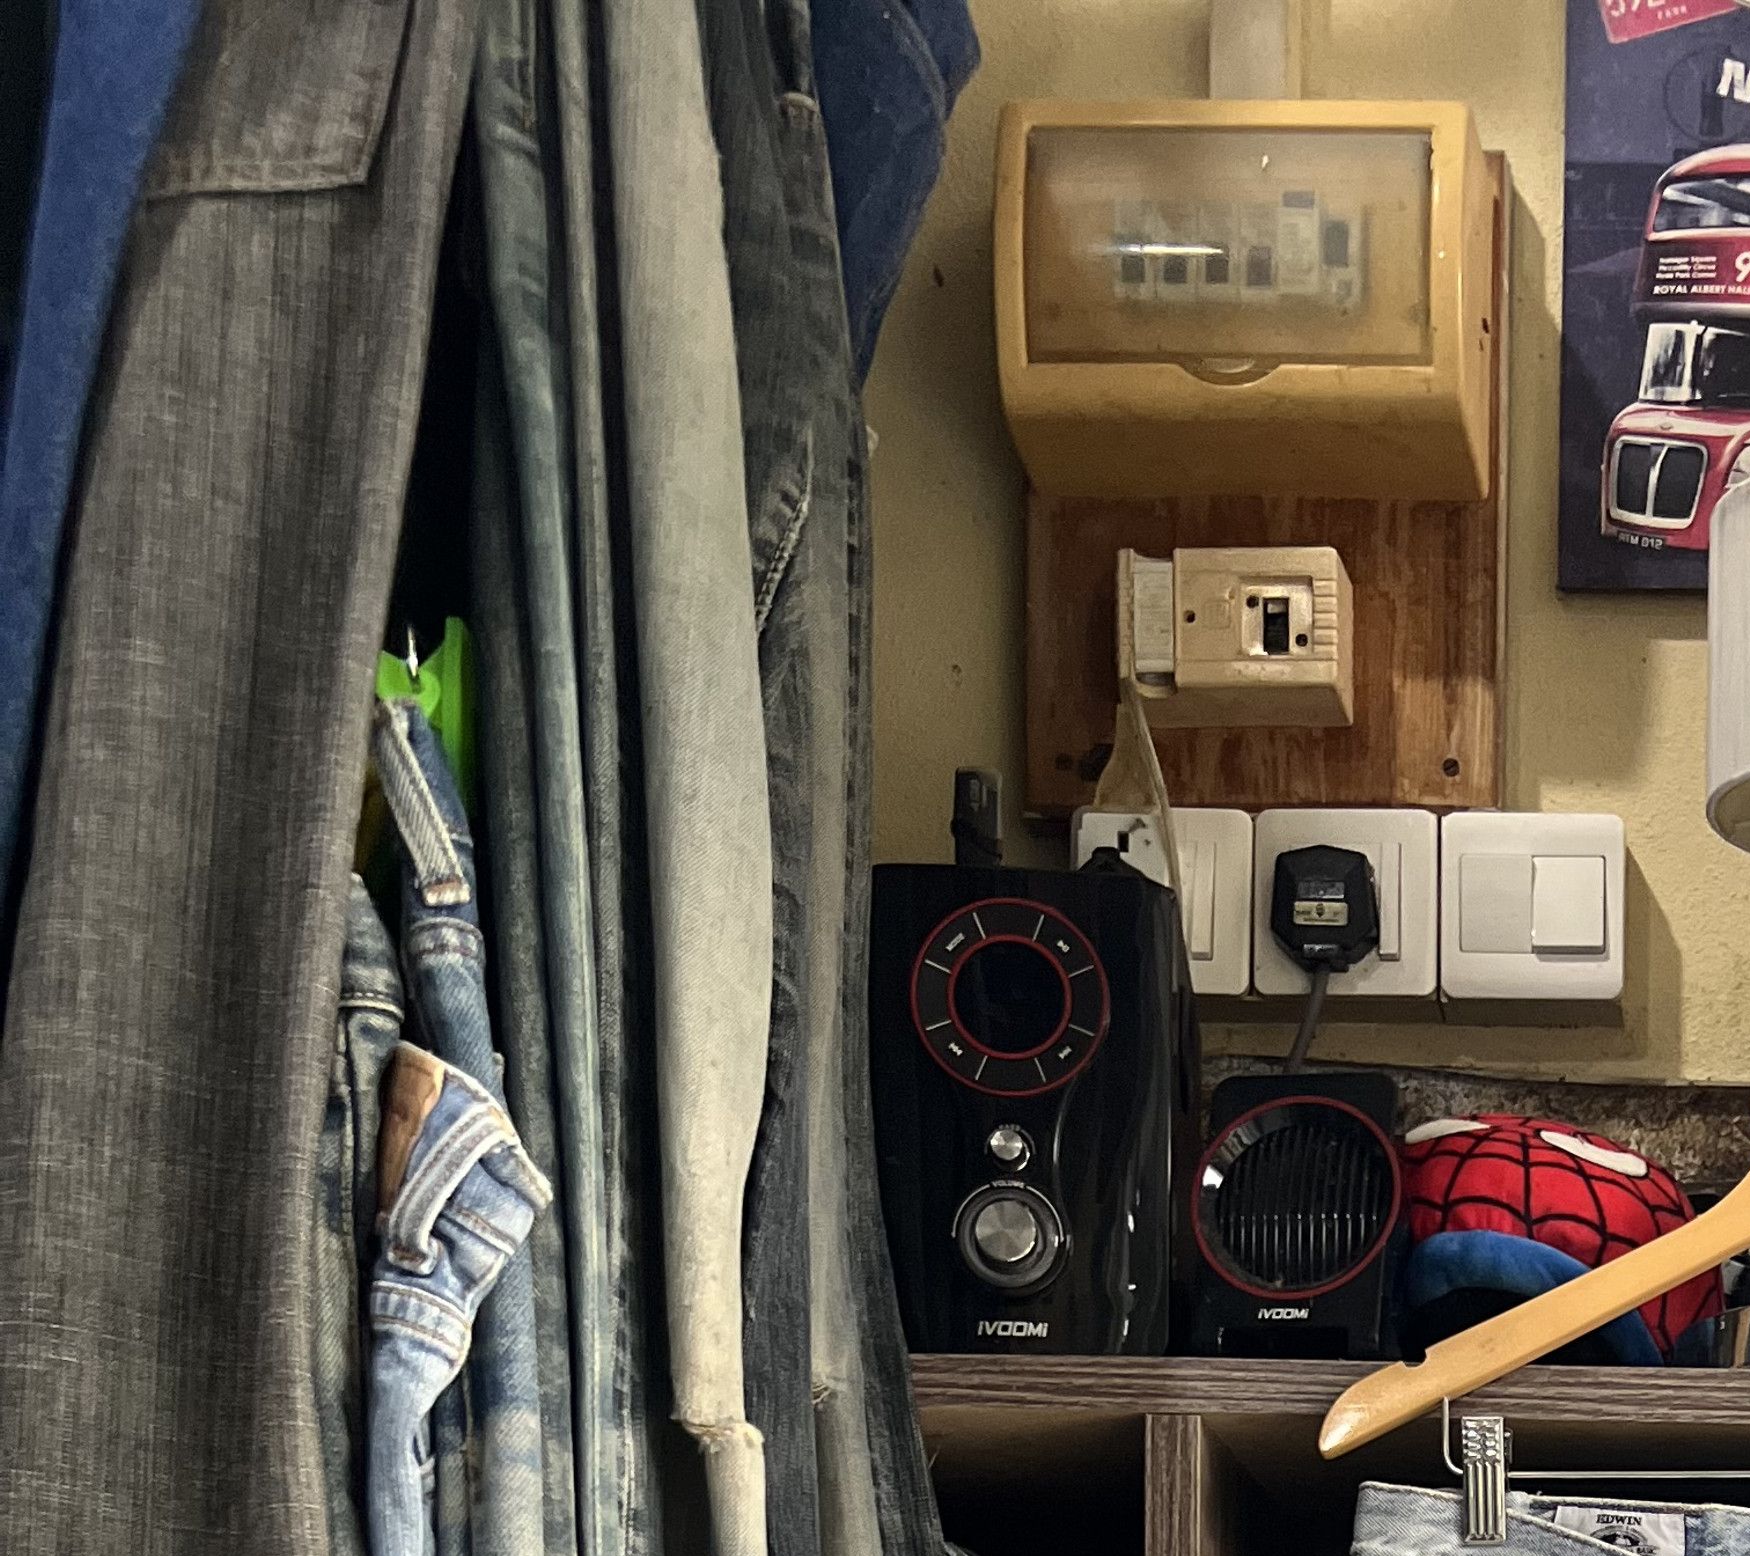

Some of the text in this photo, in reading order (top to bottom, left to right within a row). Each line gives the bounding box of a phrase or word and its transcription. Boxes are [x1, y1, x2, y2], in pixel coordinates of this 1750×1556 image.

[1653, 285, 1688, 295] ROYAL
[1690, 285, 1727, 295] ALBERT
[1597, 1514, 1642, 1526] EDWIN
